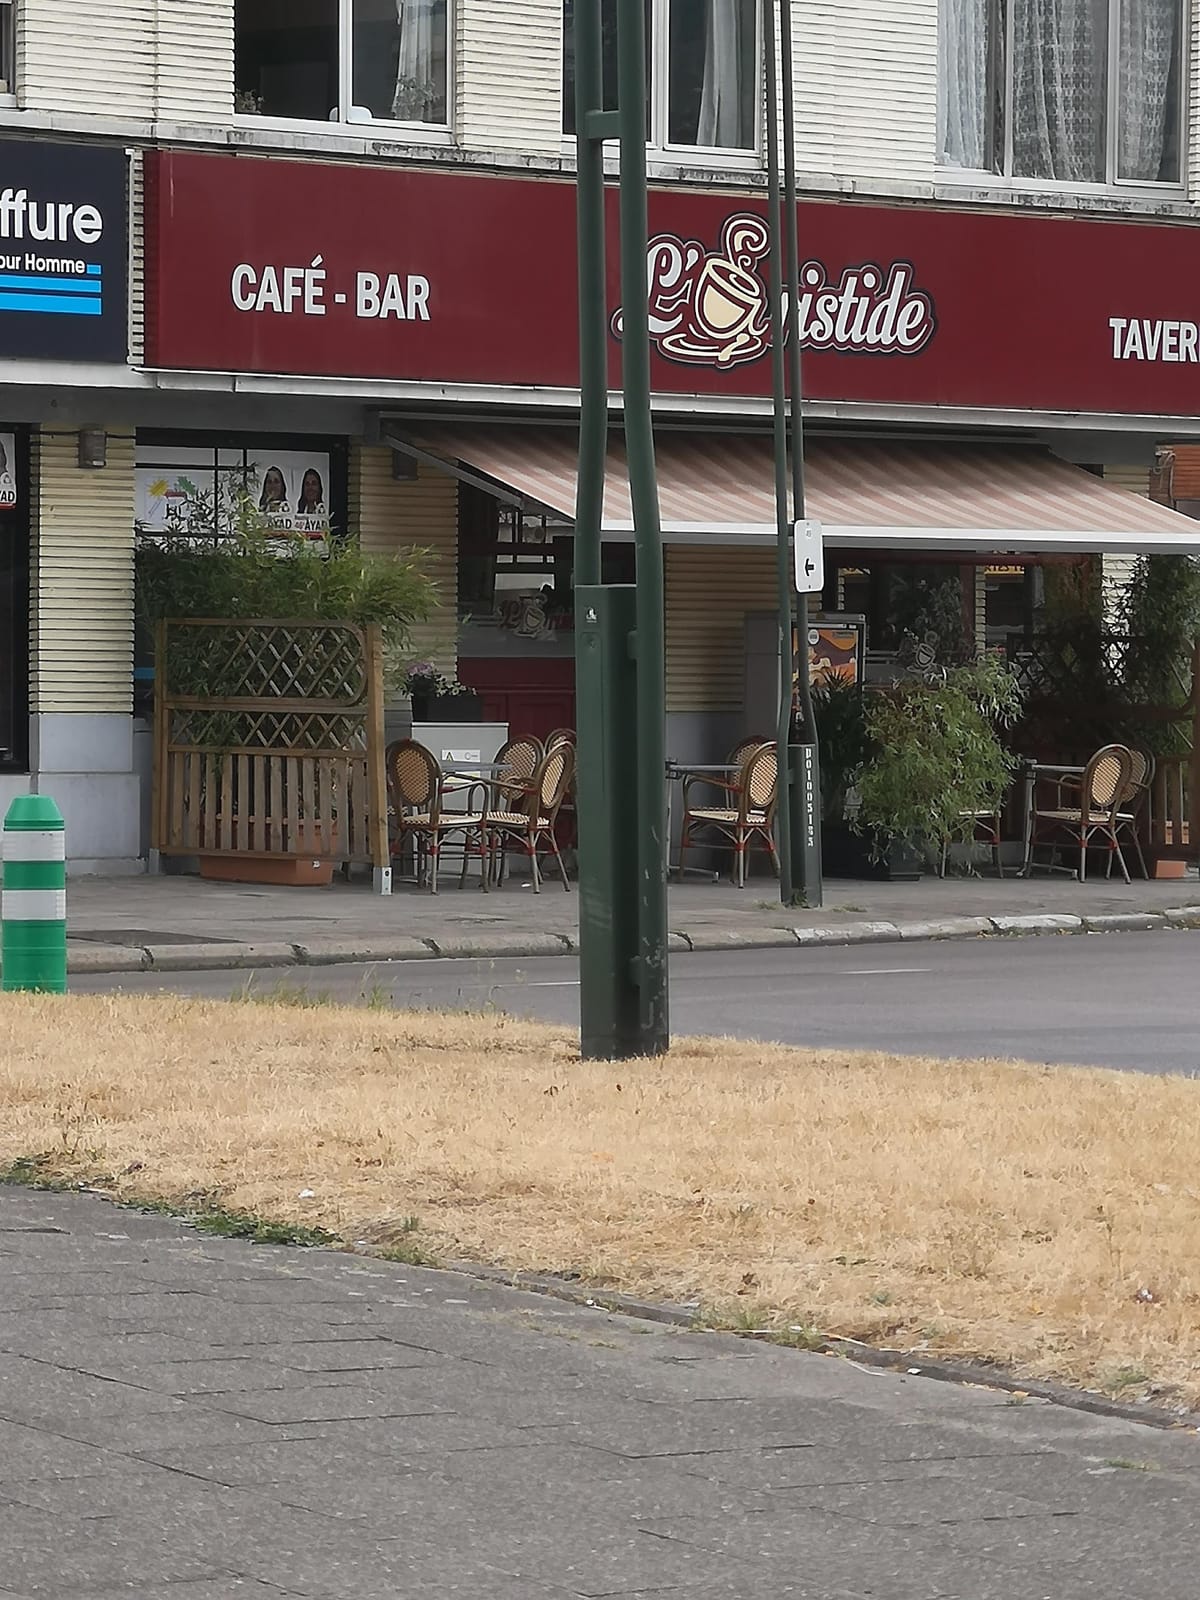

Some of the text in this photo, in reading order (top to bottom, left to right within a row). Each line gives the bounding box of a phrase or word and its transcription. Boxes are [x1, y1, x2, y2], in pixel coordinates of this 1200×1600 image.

[25, 253, 86, 274] Homme
[231, 254, 326, 314] CAFÉ
[356, 272, 430, 320] BAR
[1109, 317, 1200, 362] TAVER
